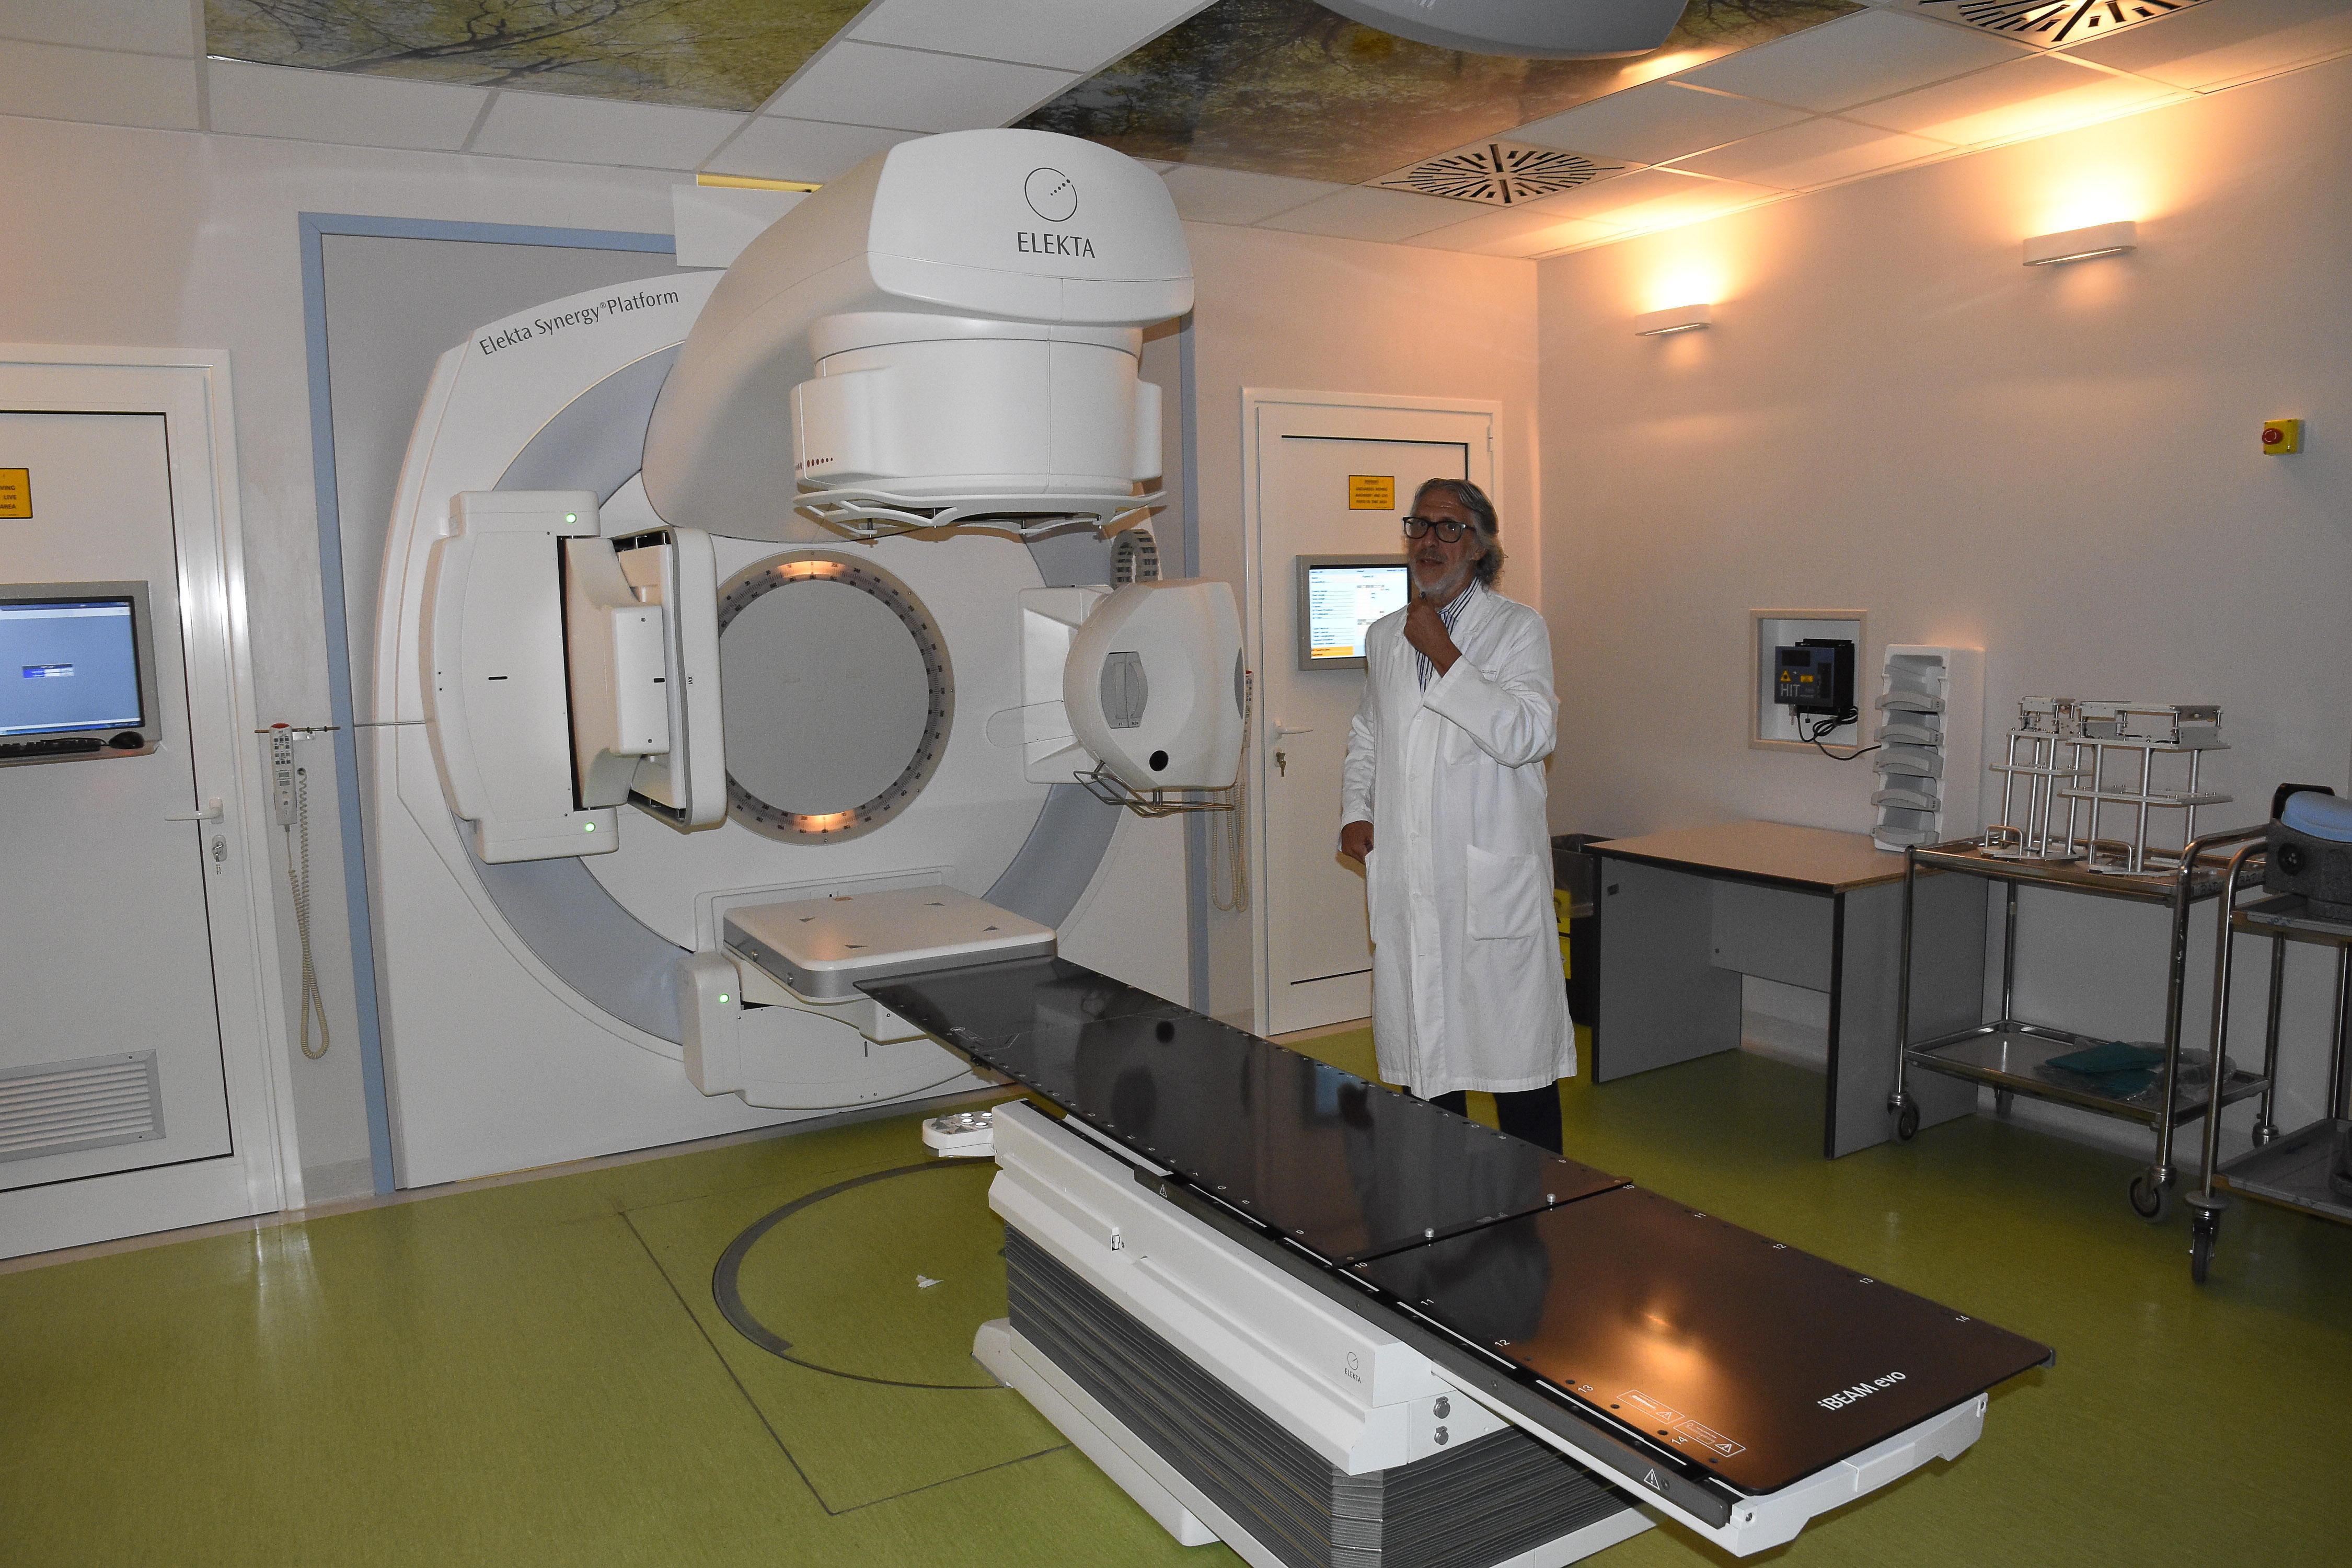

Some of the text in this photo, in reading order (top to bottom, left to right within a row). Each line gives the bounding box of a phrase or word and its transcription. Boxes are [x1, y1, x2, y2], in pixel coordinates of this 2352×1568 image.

[1018, 232, 1095, 258] ELEKTA
[479, 327, 532, 355] Elekta
[607, 291, 679, 315] Platform
[1781, 684, 1800, 697] HIT
[1955, 1315, 1970, 1323] 14
[1345, 1368, 1361, 1383] ELEKTA
[1578, 1385, 1593, 1393] 13
[1817, 1371, 1906, 1411] iBEAM evo
[1671, 1436, 1688, 1445] 14
